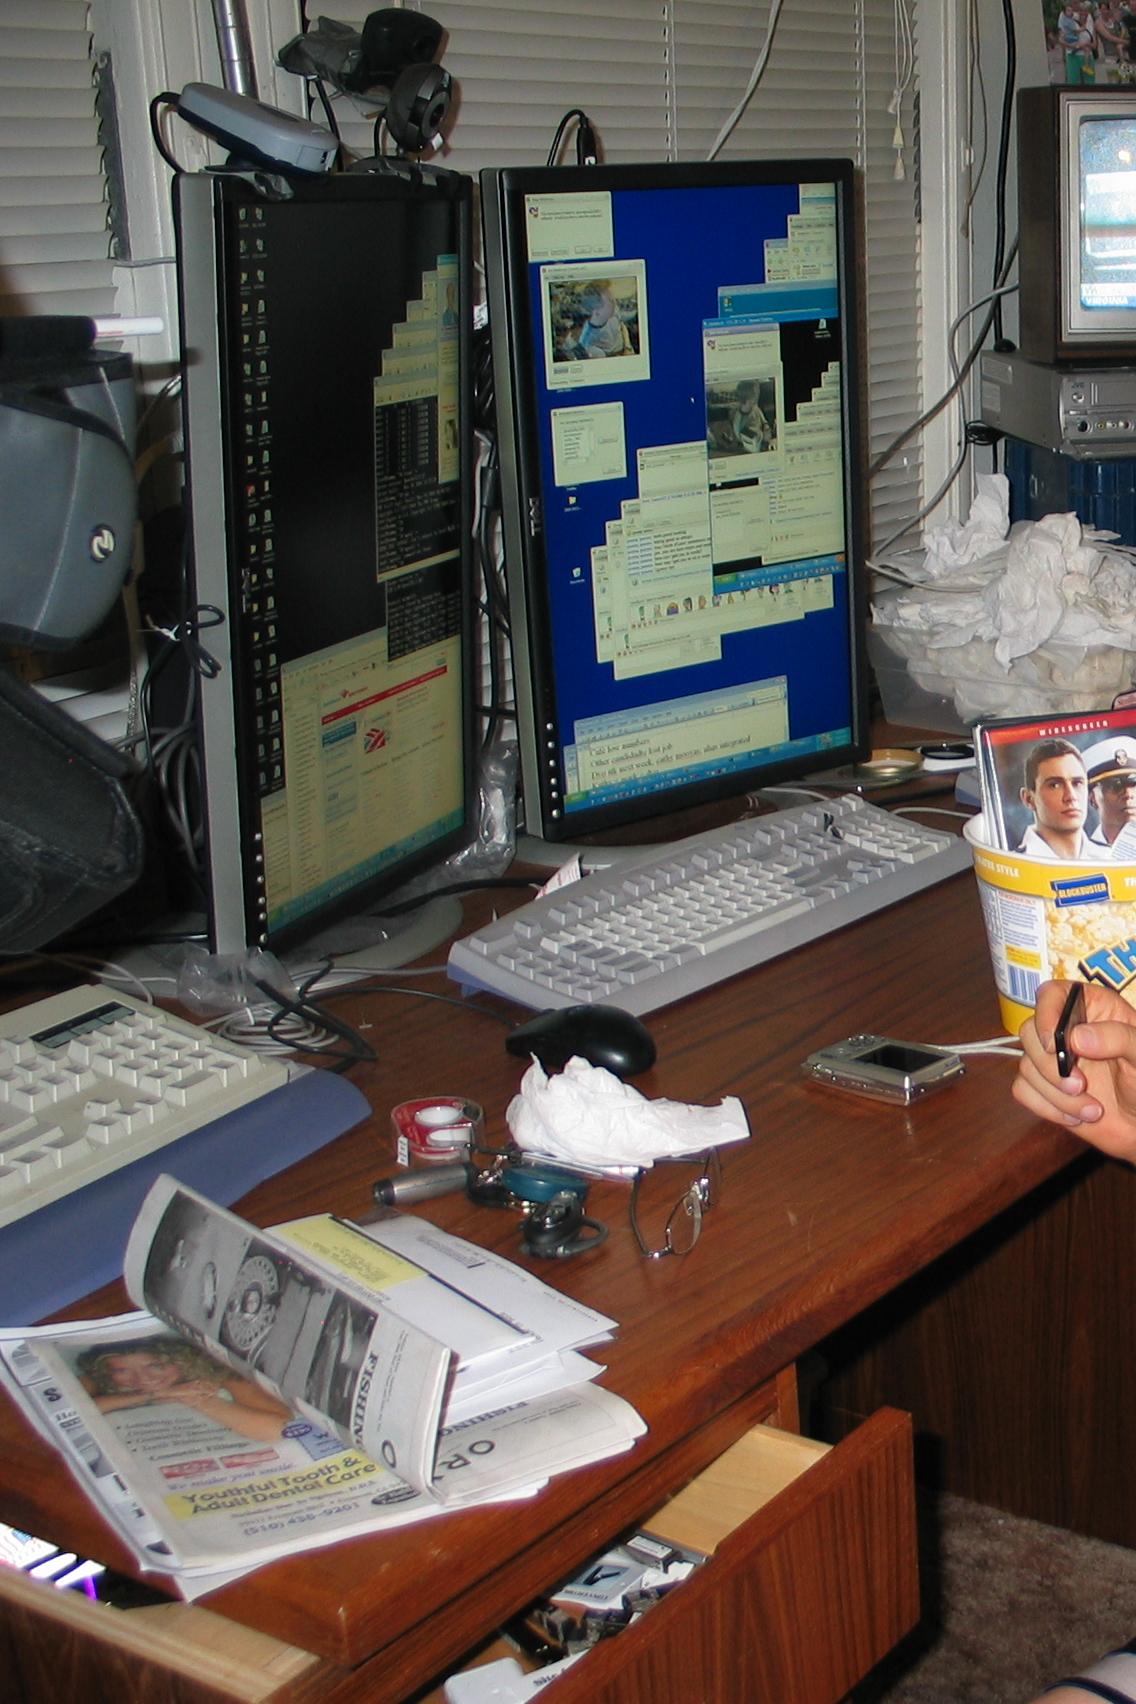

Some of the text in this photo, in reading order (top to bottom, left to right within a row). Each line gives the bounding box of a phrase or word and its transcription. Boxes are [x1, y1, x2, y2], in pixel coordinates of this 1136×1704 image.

[1058, 882, 1107, 898] BLOCKBUSTER
[181, 1456, 363, 1503] Youthful Tooth &
[192, 1495, 250, 1514] Adult
[252, 1481, 323, 1503] Dental
[326, 1462, 377, 1486] Care
